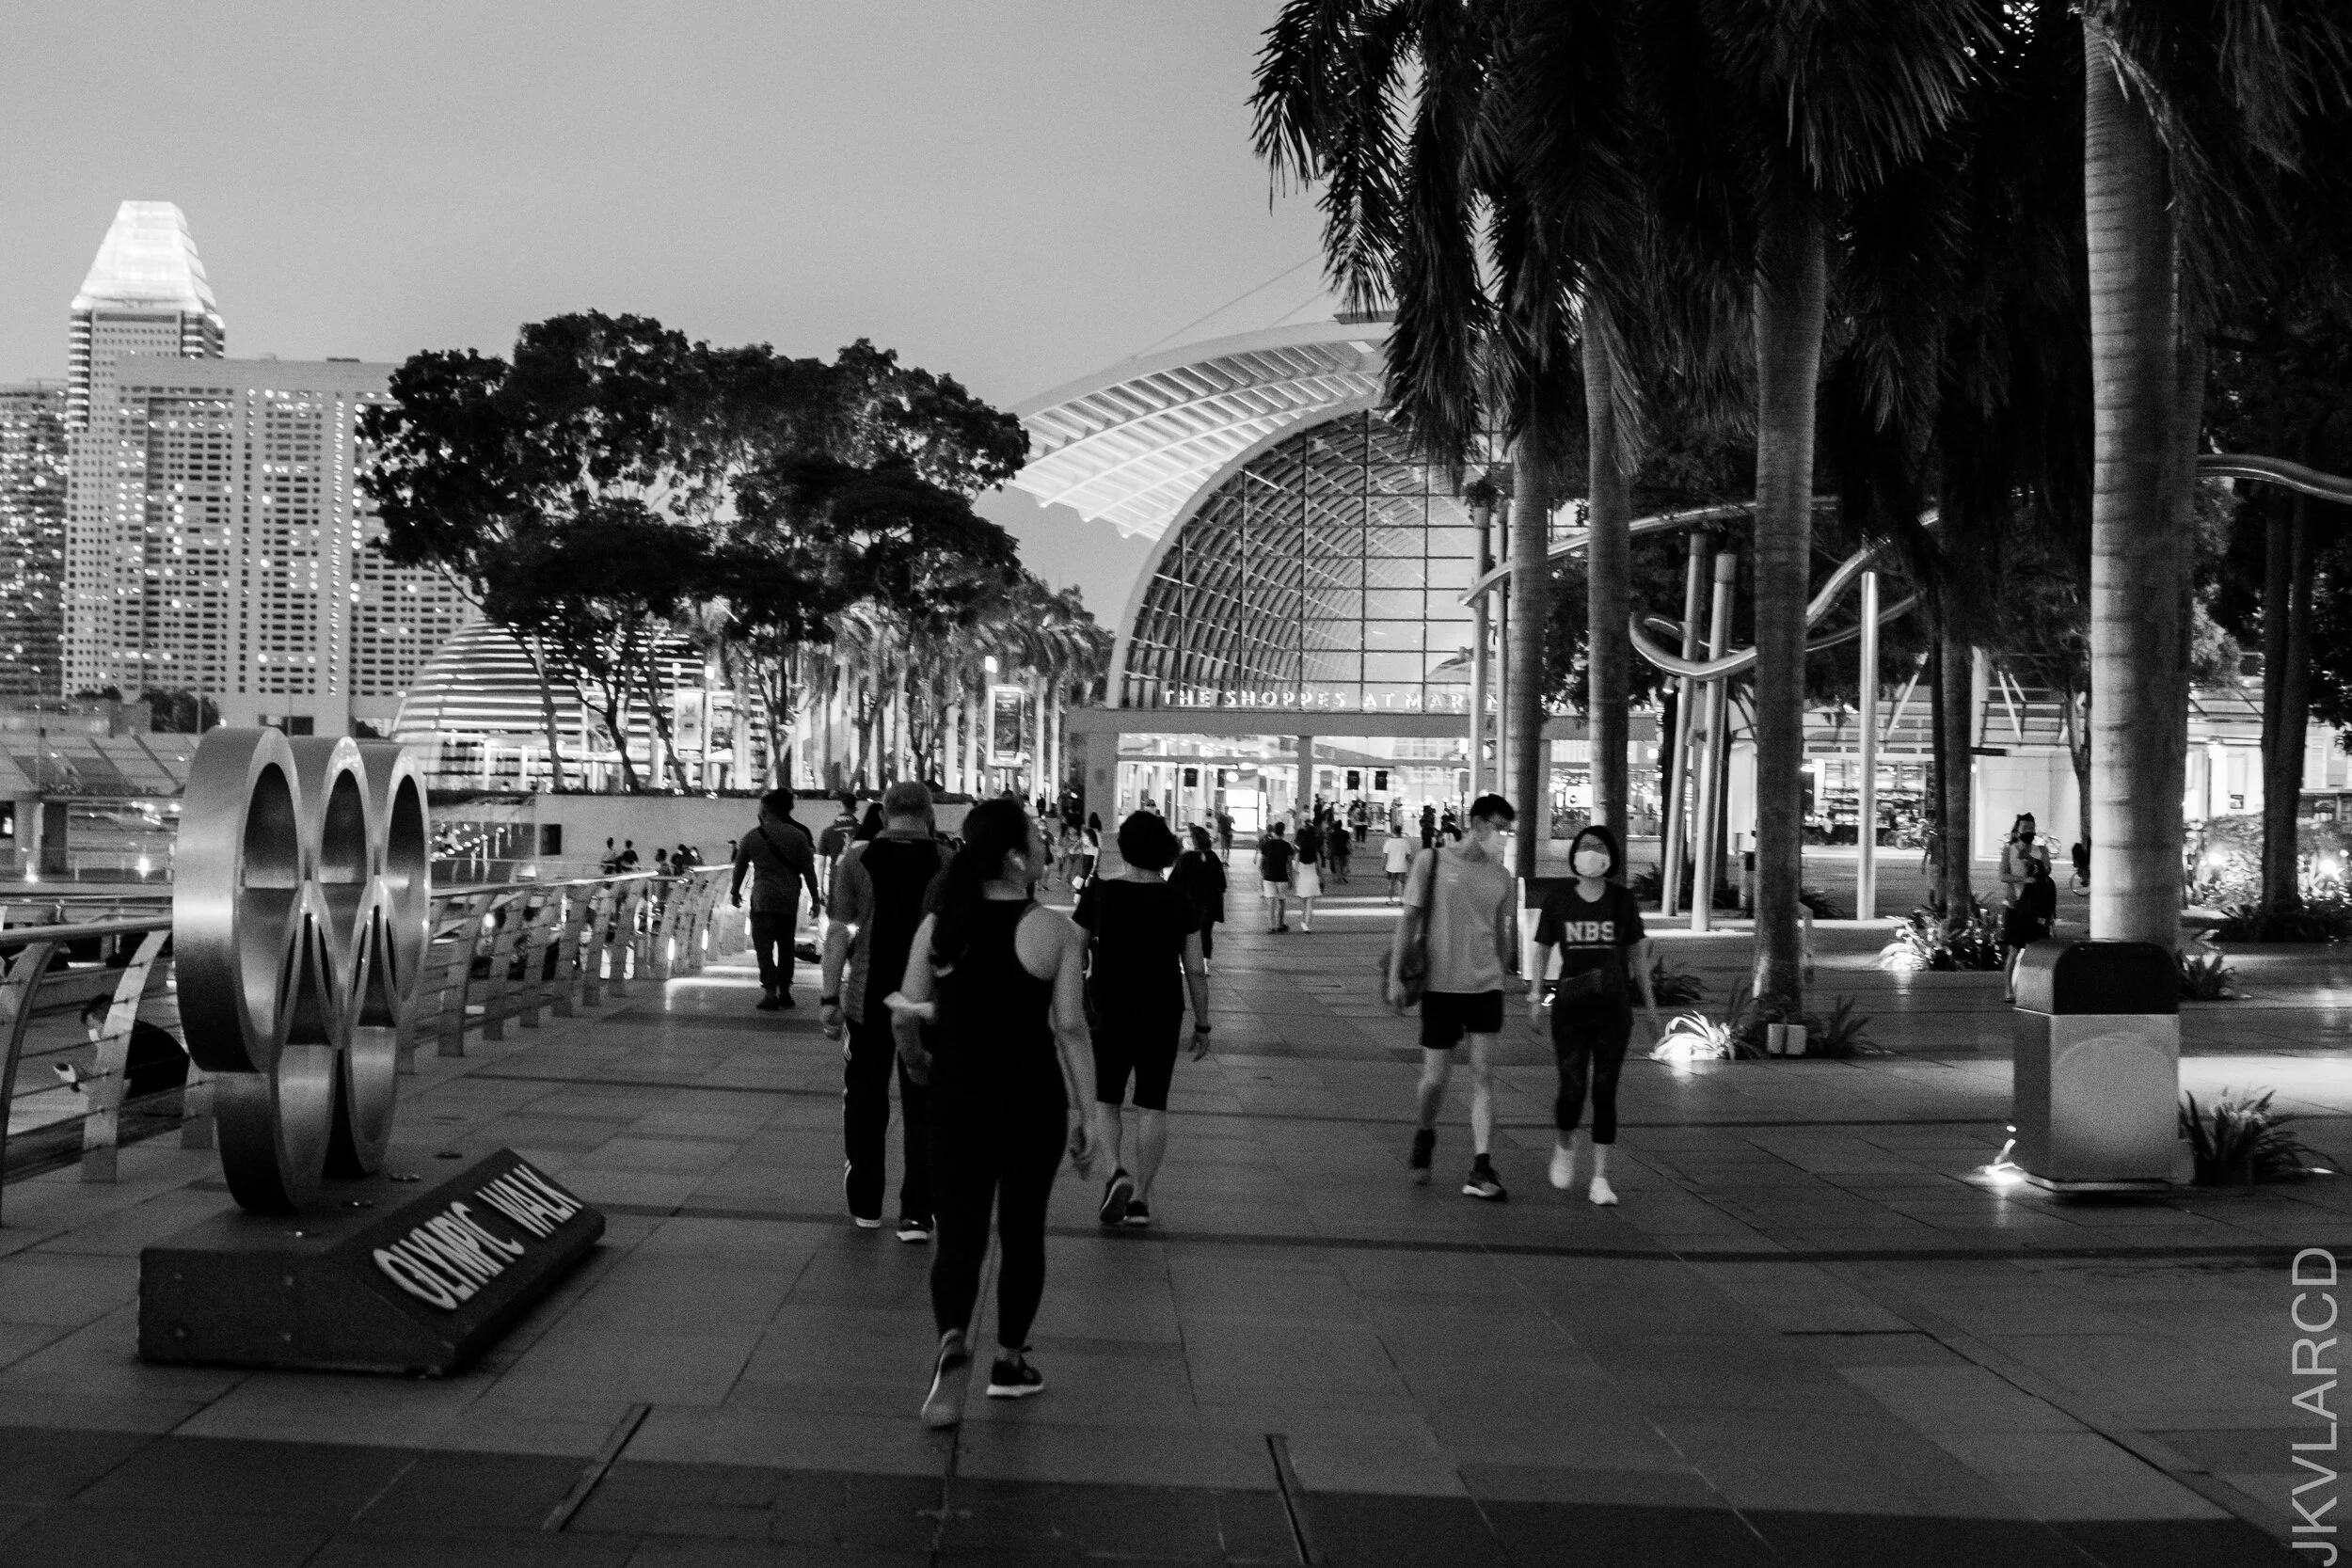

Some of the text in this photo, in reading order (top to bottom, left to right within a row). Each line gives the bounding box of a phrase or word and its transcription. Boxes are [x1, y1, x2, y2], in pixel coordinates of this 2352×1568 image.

[1164, 689, 1211, 705] THE
[1225, 689, 1346, 707] SHOPPES
[1363, 691, 1395, 707] AT
[1565, 921, 1615, 942] NBS
[373, 1163, 583, 1309] OLYMPIC WALK
